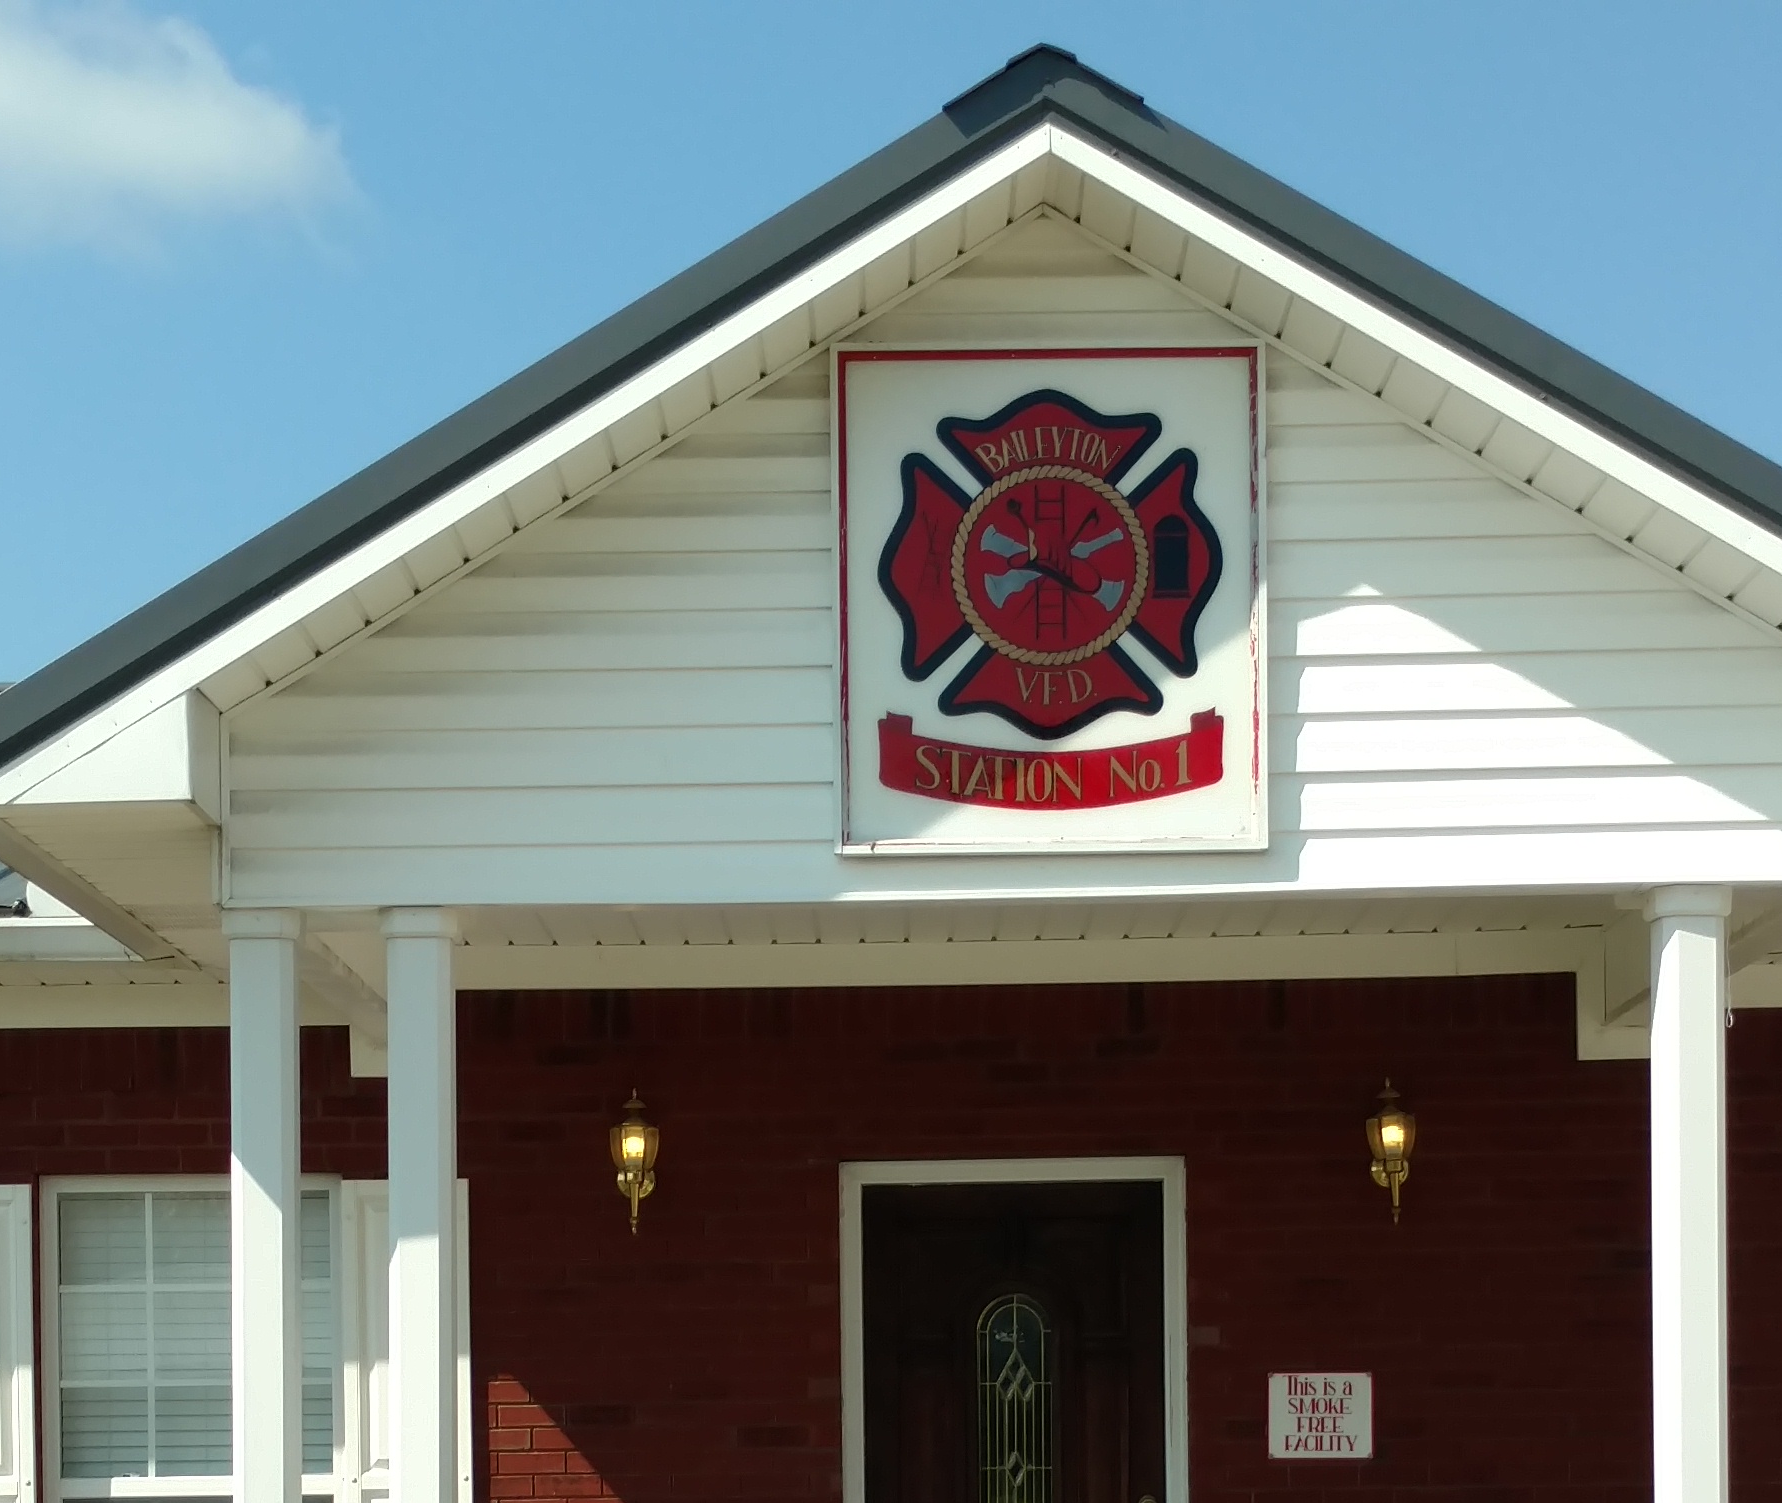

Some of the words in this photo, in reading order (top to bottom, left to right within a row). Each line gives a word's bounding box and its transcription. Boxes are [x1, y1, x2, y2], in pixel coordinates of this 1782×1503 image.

[975, 426, 1121, 474] BAILEYTON
[915, 744, 1082, 802] STATION
[1108, 748, 1165, 797] No.
[1175, 739, 1194, 784] 1
[1283, 1375, 1317, 1396] This
[1323, 1377, 1337, 1396] is
[1342, 1380, 1353, 1396] a
[1288, 1398, 1353, 1415] SMOKE
[1297, 1416, 1344, 1433] FREE
[1284, 1434, 1358, 1452] FACILITY
